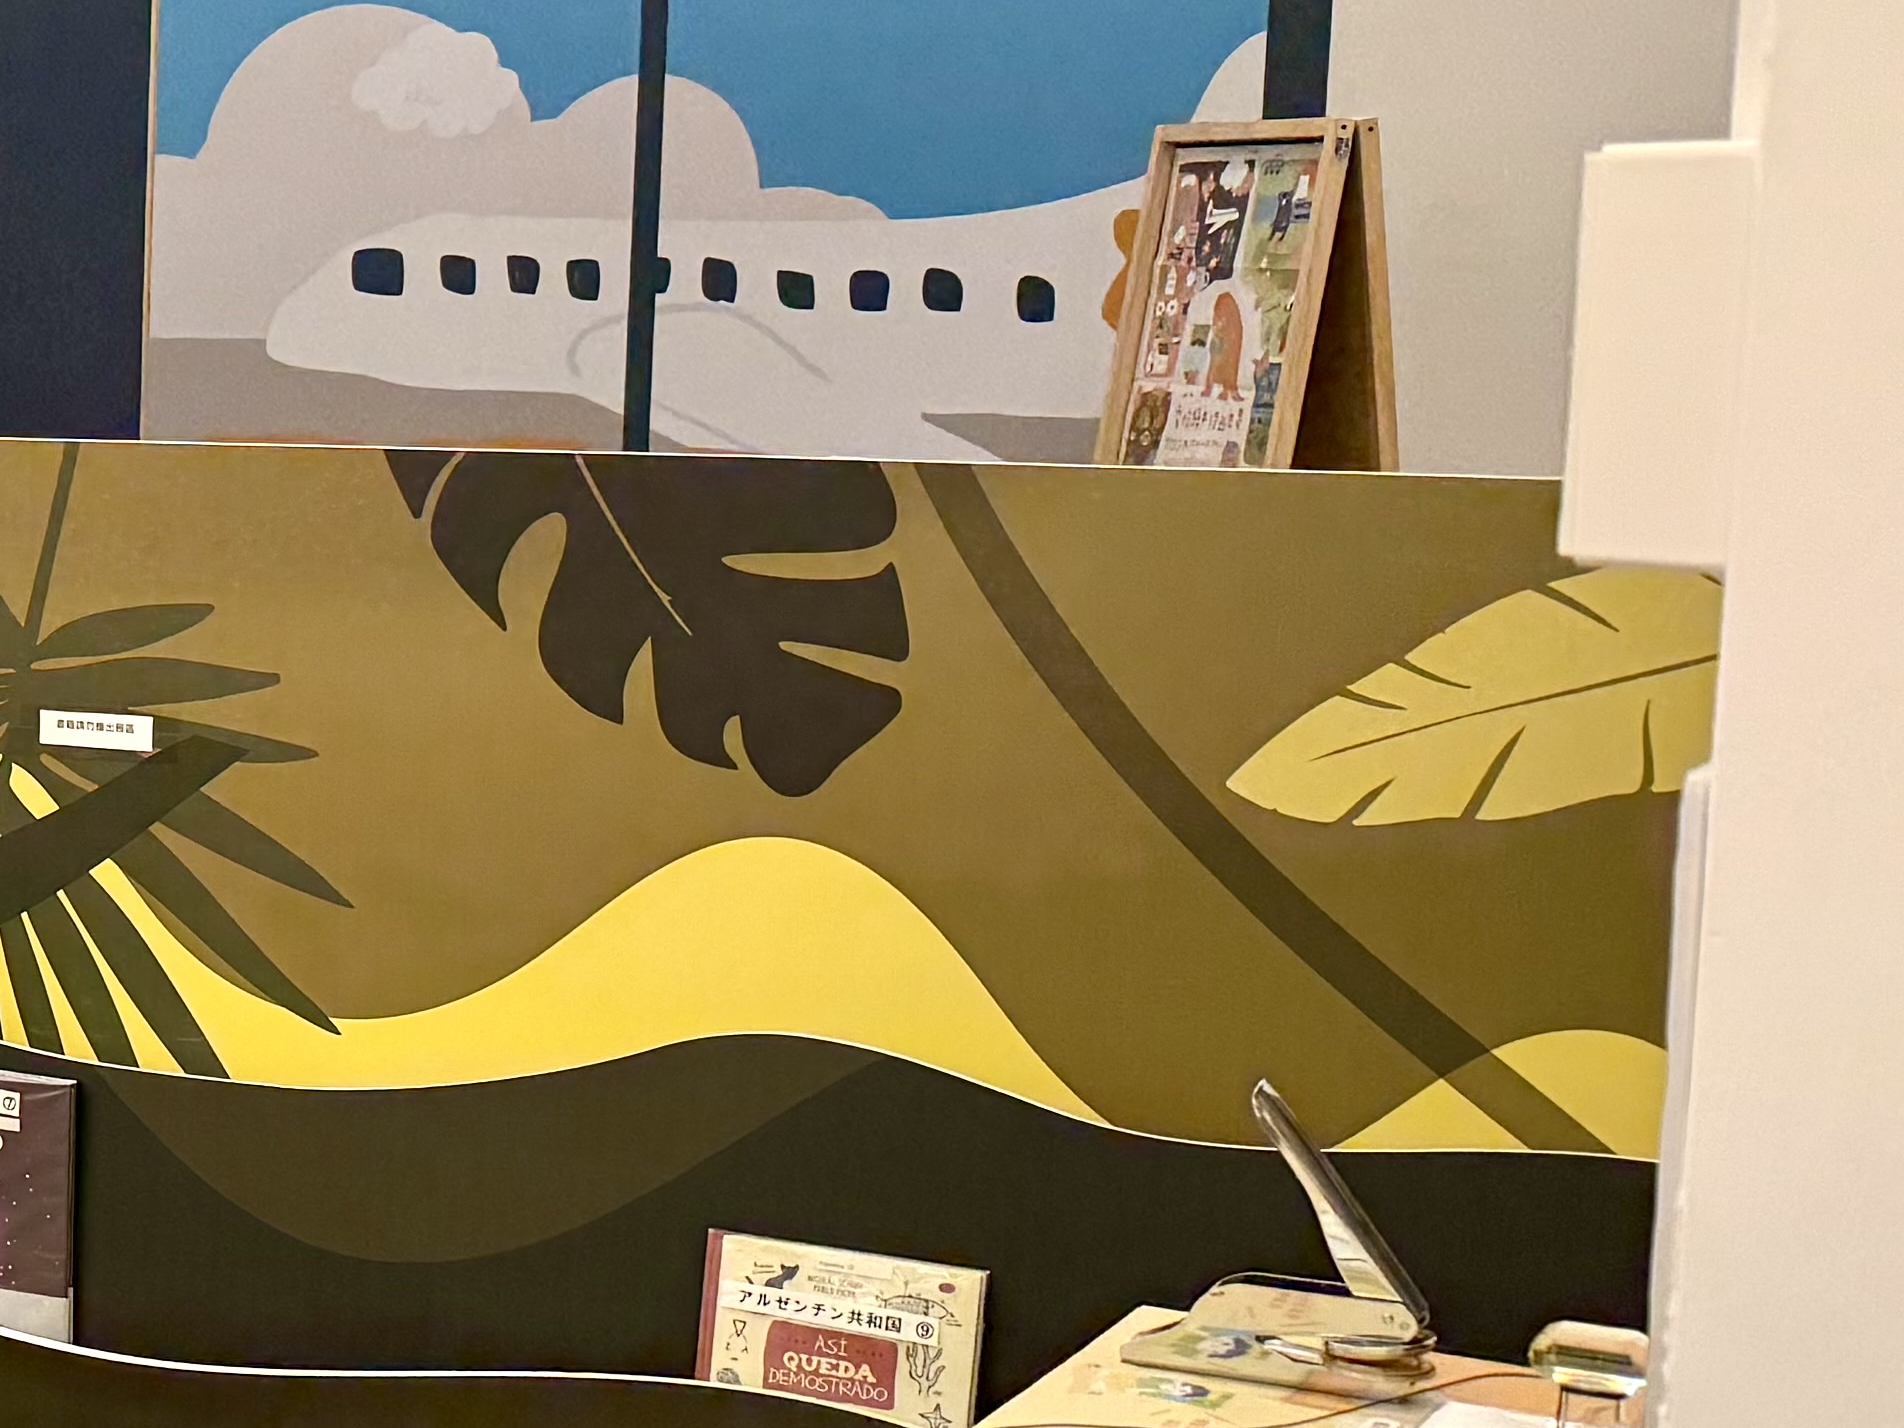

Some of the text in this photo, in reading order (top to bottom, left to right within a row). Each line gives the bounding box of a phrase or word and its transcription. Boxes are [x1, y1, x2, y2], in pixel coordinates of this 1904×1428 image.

[738, 1289, 935, 1340] アルゼンチン共和国 ⑨
[814, 1334, 848, 1357] ASÍ
[783, 1351, 877, 1383] QUEDA
[768, 1367, 888, 1402] DEMOSTRADO
